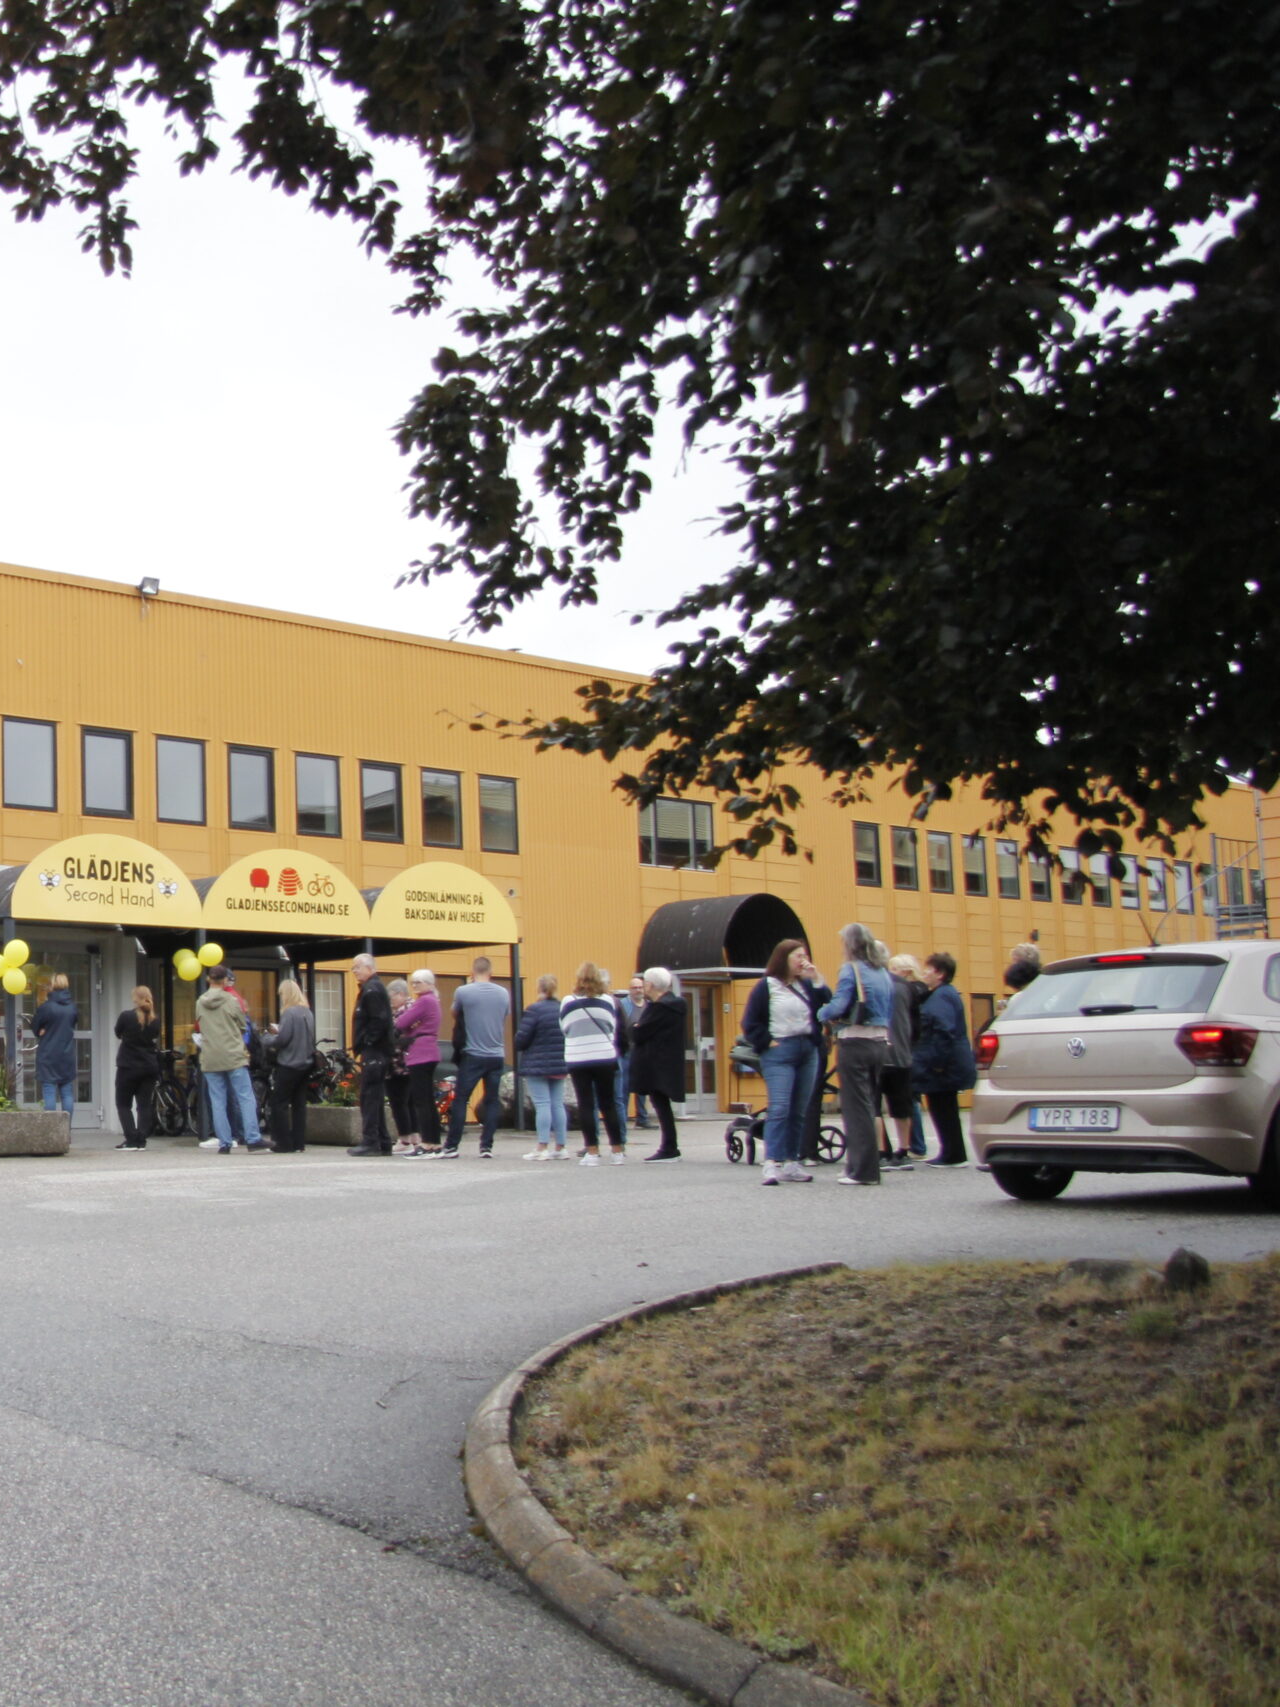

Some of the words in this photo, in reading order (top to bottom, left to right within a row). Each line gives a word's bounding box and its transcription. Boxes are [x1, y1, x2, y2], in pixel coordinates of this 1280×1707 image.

[63, 854, 155, 884] GLÄDJENS
[64, 883, 115, 906] Second
[120, 887, 155, 908] Hand
[226, 897, 350, 917] GLADJENSSECONDHAND.SE
[405, 908, 446, 921] BAKSIDAN
[448, 911, 458, 922] AV
[460, 911, 485, 923] HUSET
[1043, 1109, 1073, 1126] YPR
[1080, 1109, 1110, 1126] 188
